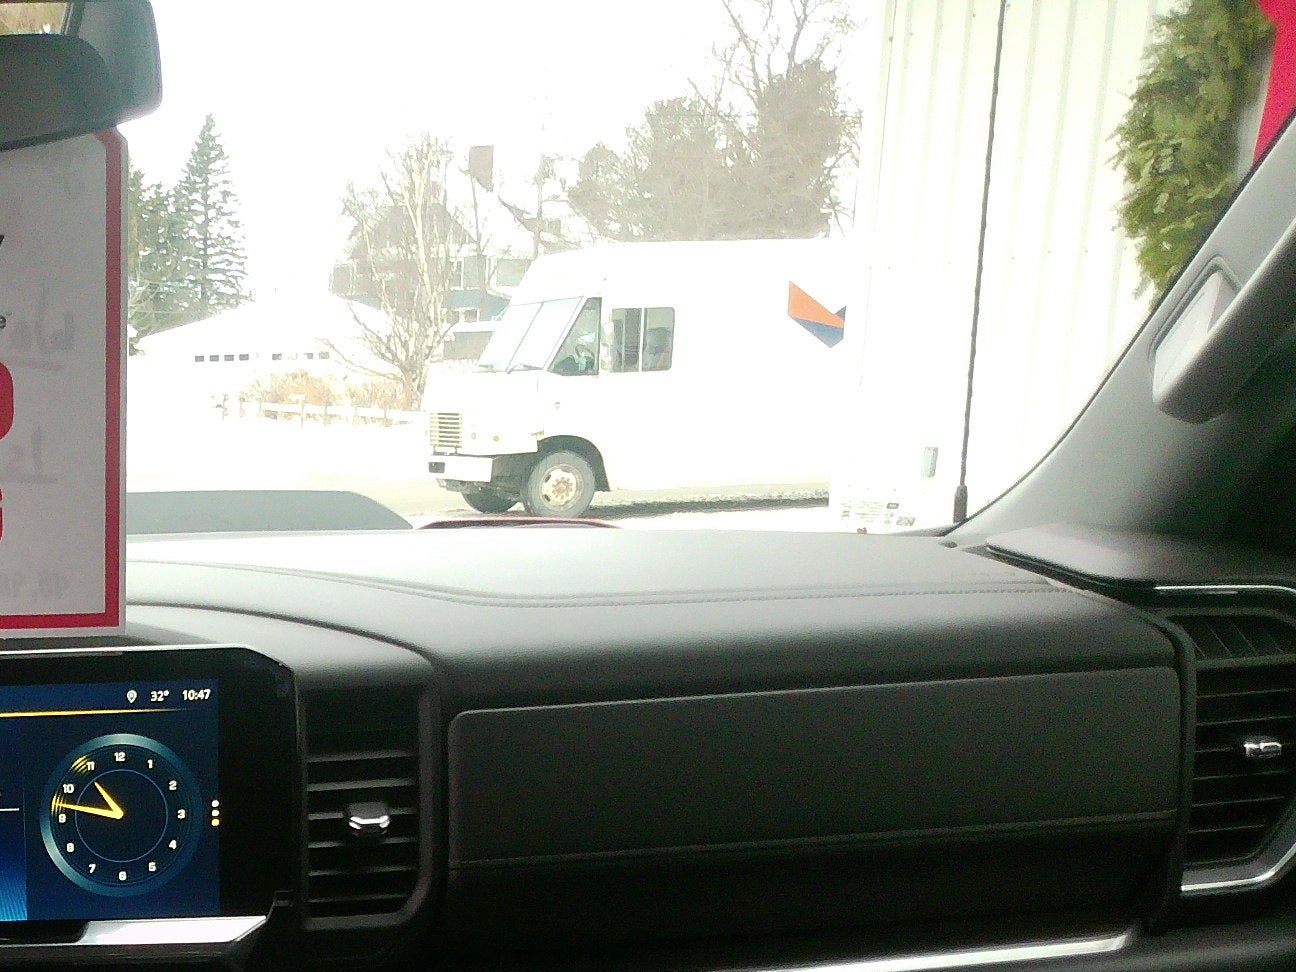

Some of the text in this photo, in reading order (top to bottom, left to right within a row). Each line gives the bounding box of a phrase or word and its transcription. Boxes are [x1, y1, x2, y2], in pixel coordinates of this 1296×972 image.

[182, 688, 211, 701] 10:47
[113, 751, 126, 762] 12
[86, 761, 95, 771] 11
[147, 759, 154, 769] 1
[62, 783, 75, 794] 10
[168, 780, 177, 791] 2
[177, 808, 186, 819] 3
[168, 839, 177, 849] 4
[88, 863, 97, 873] 7
[148, 861, 157, 872] 5
